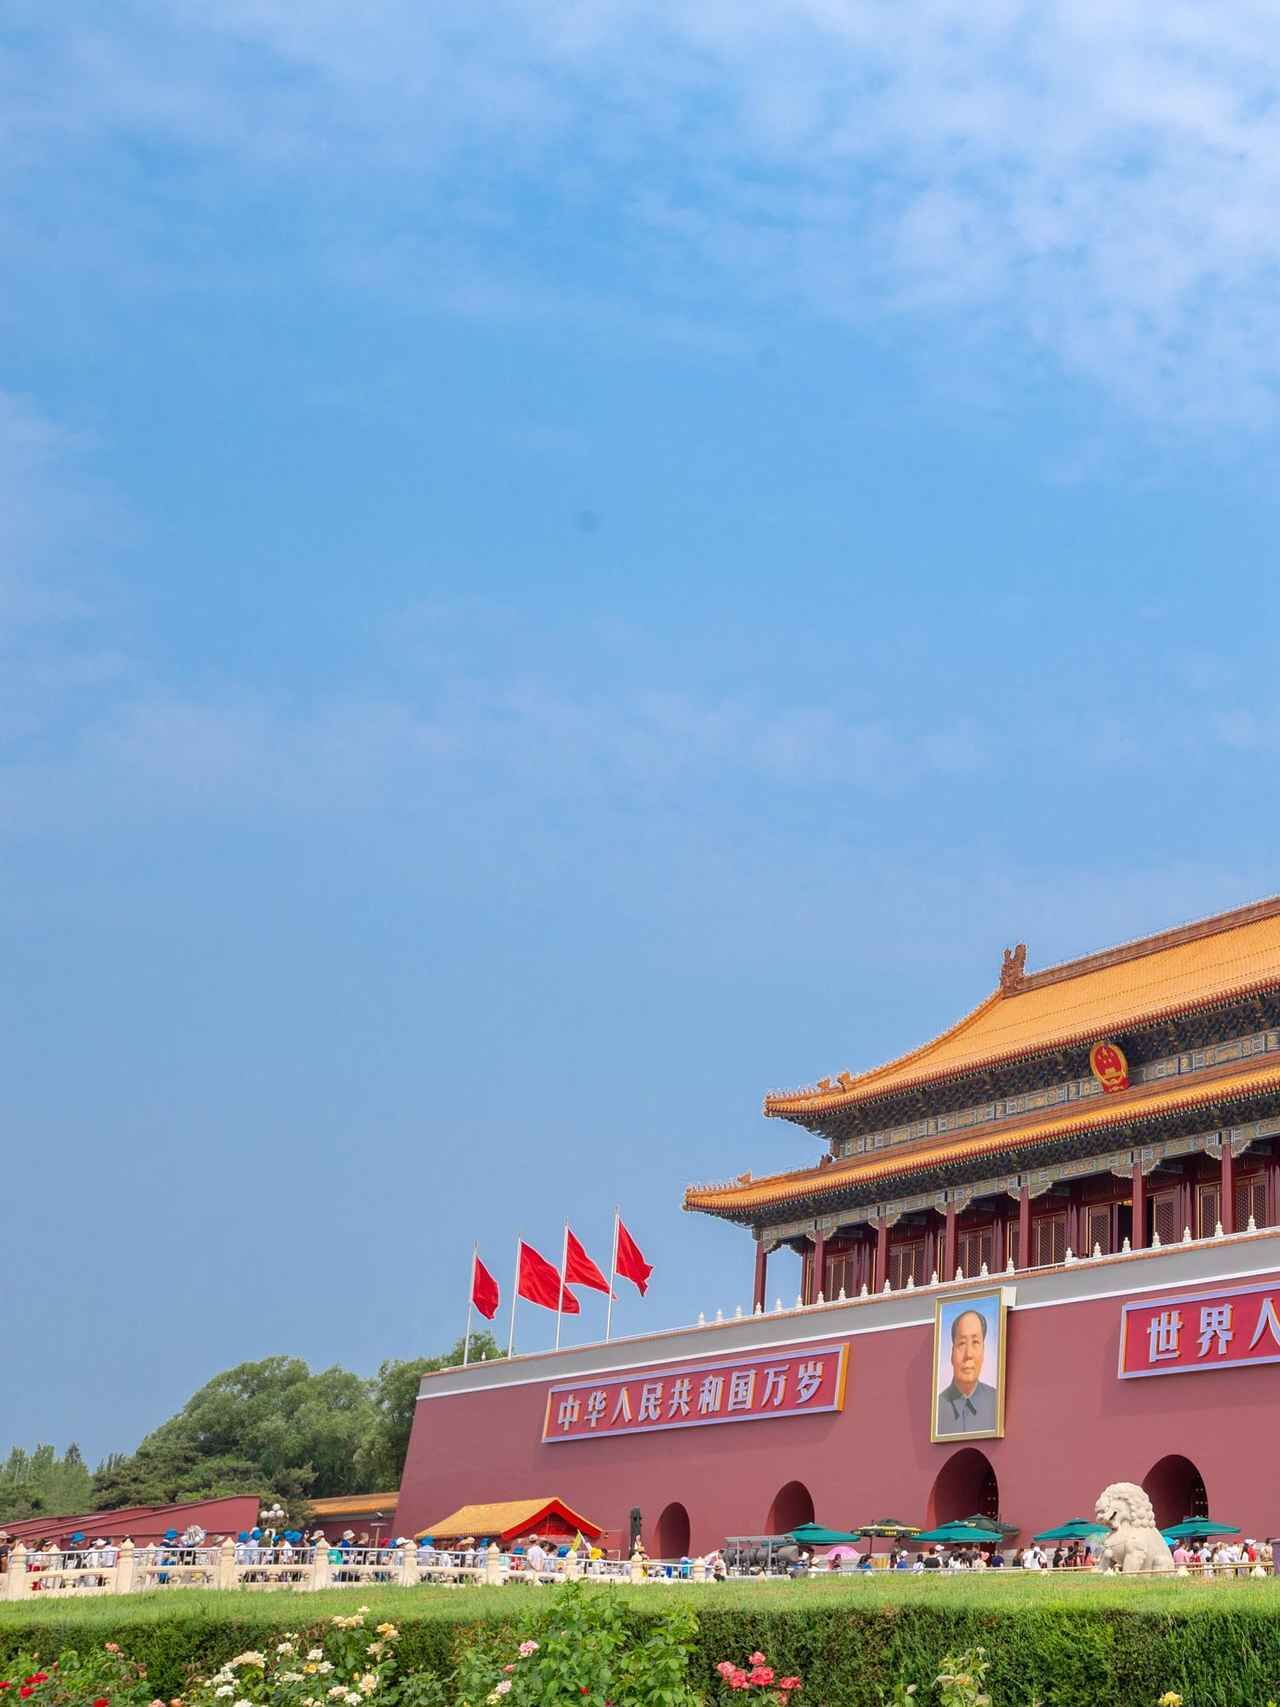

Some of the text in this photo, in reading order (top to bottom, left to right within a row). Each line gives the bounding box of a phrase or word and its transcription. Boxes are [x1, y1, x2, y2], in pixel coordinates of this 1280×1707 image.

[558, 1361, 824, 1430] 中华人民共和国万岁
